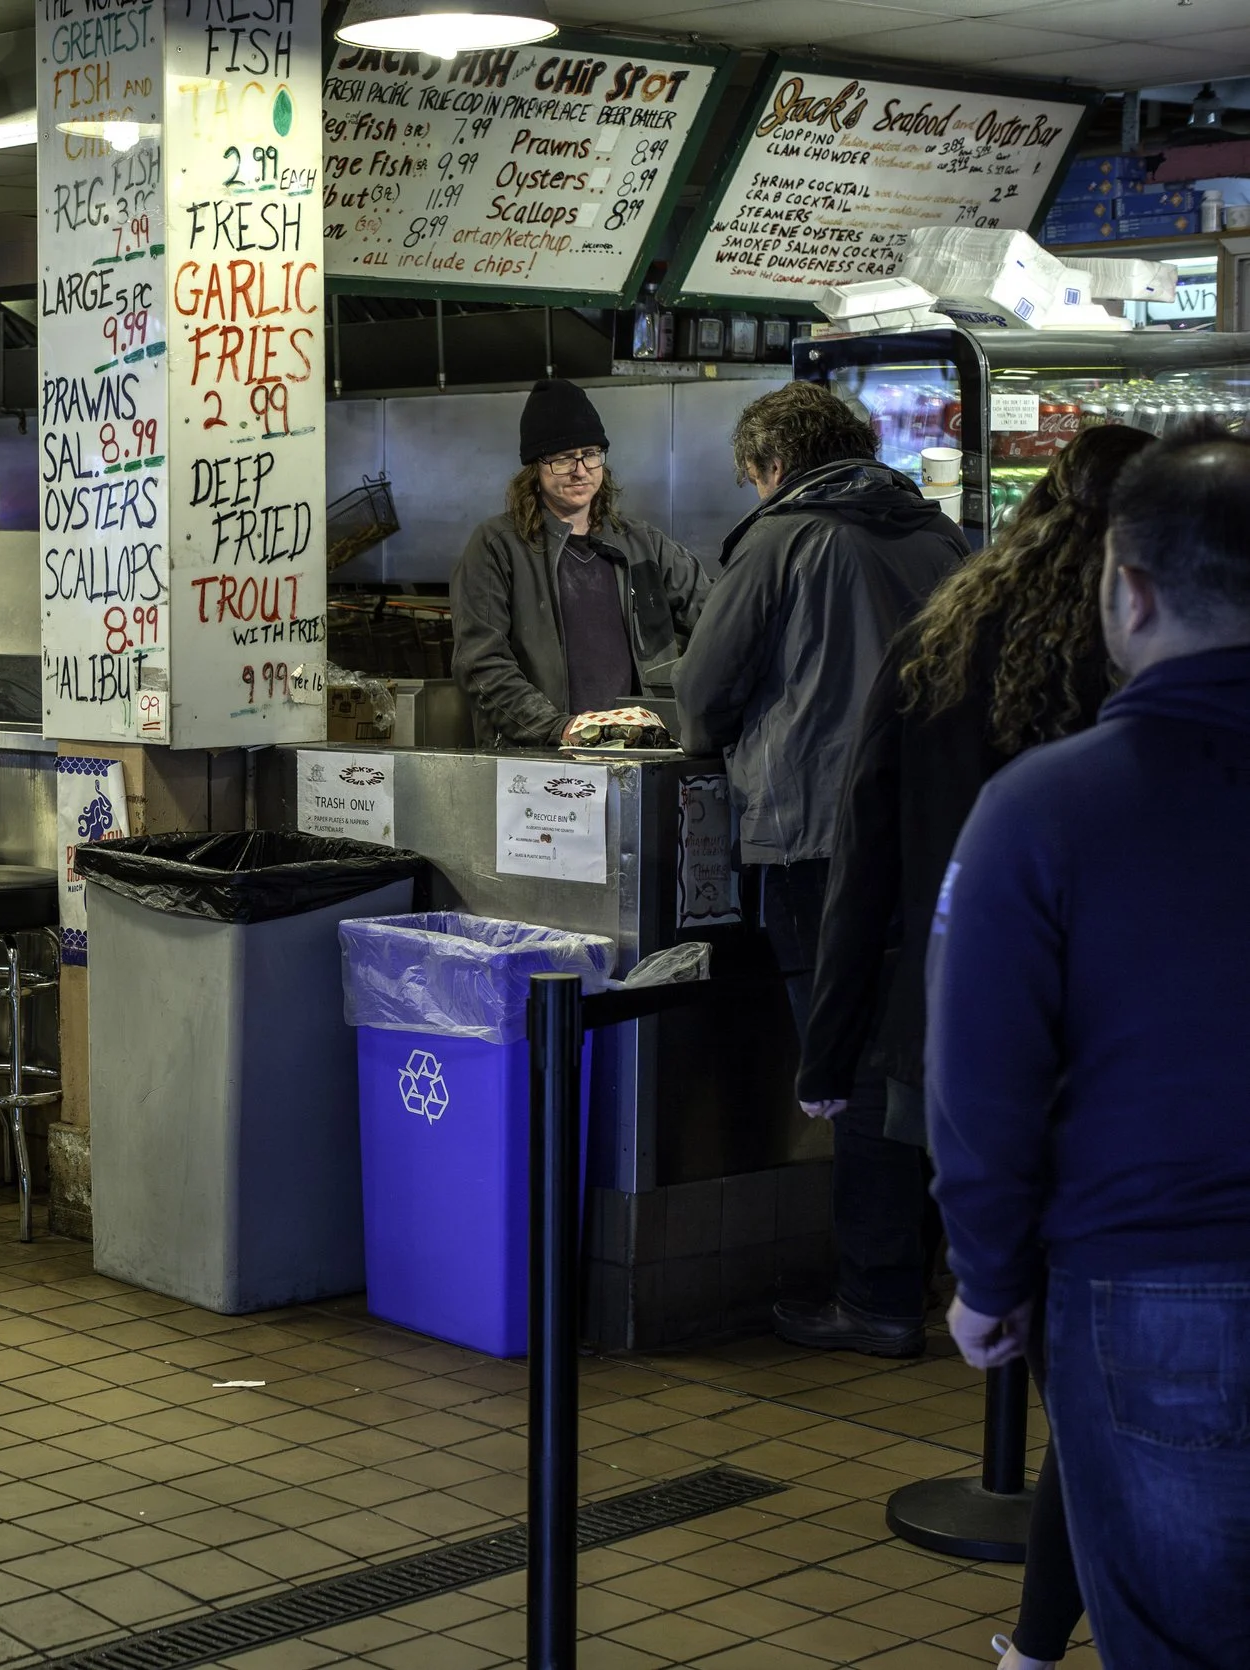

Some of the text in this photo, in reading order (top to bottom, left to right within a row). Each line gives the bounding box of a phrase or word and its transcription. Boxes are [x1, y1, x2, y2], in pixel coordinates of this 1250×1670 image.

[52, 7, 151, 64] GREATEST
[205, 25, 292, 79] FISH
[53, 62, 152, 109] FISH AND
[322, 77, 367, 103] FRESH
[418, 85, 456, 111] TRUE
[452, 91, 484, 114] COD
[500, 96, 536, 120] PIKE
[543, 99, 593, 123] PLACE
[596, 105, 632, 127] BEER
[605, 61, 691, 103] SPOT
[178, 80, 298, 141] TACO
[353, 112, 398, 141] Fish
[451, 118, 493, 146] 7.99
[755, 77, 869, 138] Jack's
[872, 99, 962, 138] Seafood
[975, 109, 1030, 148] Oyster
[1023, 113, 1064, 148] Bar
[510, 128, 669, 166] Prawns 8.99
[766, 142, 801, 157] CLAM
[804, 145, 871, 165] CHOWDER
[773, 127, 835, 145] CIOPPINO
[111, 145, 161, 196] FISH
[222, 145, 317, 190] 2.99 EACH
[324, 155, 363, 179] rge
[369, 150, 413, 177] Fish
[437, 152, 479, 182] 9.99
[496, 161, 658, 197] Oysters 8.99
[751, 172, 805, 190] SHRIMP
[808, 178, 871, 198] COCKTAIL
[53, 176, 110, 234] REG.
[425, 183, 464, 211] 11.99
[604, 199, 645, 231] 8.99
[736, 205, 813, 223] STEAMERS
[746, 189, 783, 203] CRAB
[786, 192, 852, 212] COCKTAIL
[955, 205, 979, 223] 7.99
[112, 213, 151, 258] 7.99
[187, 201, 301, 253] FRESH
[403, 215, 449, 248] 8.99
[722, 235, 905, 263] SMOKED SALMON COCKTAIL
[729, 219, 801, 239] QUILCENE
[803, 226, 864, 243] OYSTERS
[398, 251, 466, 272] include
[474, 251, 538, 279] chips!
[715, 250, 897, 276] WHOLE DUNGENESS CRAB
[42, 268, 115, 317] LARGE
[132, 283, 153, 312] PC
[174, 260, 319, 322] GARLIC
[103, 310, 149, 356] 9.99
[188, 324, 315, 386] FRIES
[42, 373, 140, 426] PRAWNS
[43, 418, 158, 484] SAL. 8.99
[189, 451, 275, 508] DEEP
[44, 476, 158, 534] OYSTERS
[212, 501, 311, 565] FRIED
[44, 542, 163, 602] SCALLOPS
[191, 574, 300, 623] TROUT
[104, 606, 159, 655] 8.99
[233, 615, 326, 646] WITH FRIES
[315, 795, 375, 811] TRASH ONLY
[533, 813, 569, 823] RECYCLE BIN
